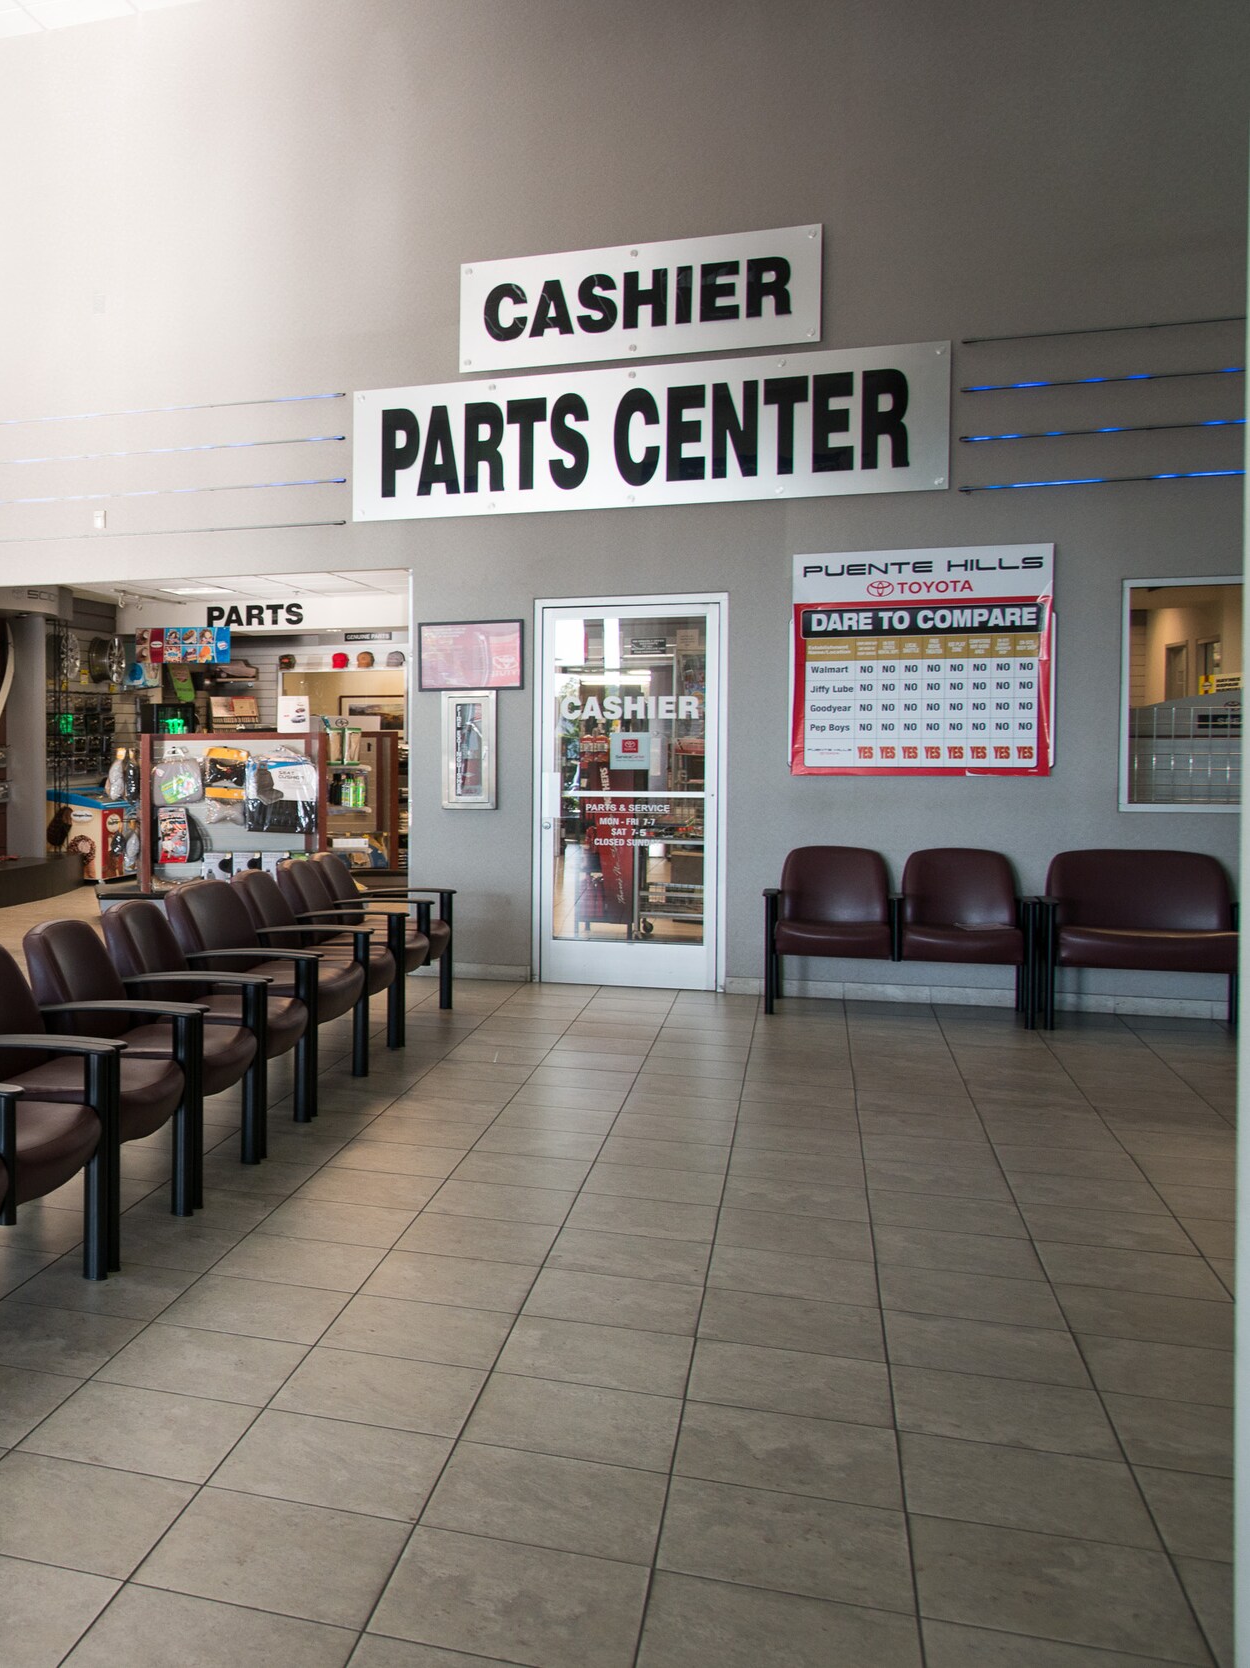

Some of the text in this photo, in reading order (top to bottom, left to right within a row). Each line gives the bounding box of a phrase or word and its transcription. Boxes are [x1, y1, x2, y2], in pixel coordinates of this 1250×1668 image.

[483, 256, 791, 342] CASHIER
[381, 368, 909, 498] PARTS CENTER
[803, 556, 1044, 578] PUENTE HILLS
[897, 580, 973, 594] TOYOTA
[207, 603, 303, 627] PARTS
[811, 607, 1037, 631] DARE TO COMPARE
[811, 666, 849, 674] Walmart
[882, 665, 895, 673] NO
[904, 664, 917, 672] NO
[927, 664, 940, 672] NO
[997, 663, 1010, 671] NO
[810, 685, 830, 695] Jiffy
[832, 685, 854, 693] Lube
[950, 682, 963, 690] NO
[973, 682, 986, 690] NO
[1019, 681, 1033, 689] NO
[561, 696, 699, 719] CASHIER
[810, 704, 852, 713] Goodyear
[904, 703, 917, 711] NO
[927, 703, 940, 711] NO
[996, 702, 1009, 710] NO
[1019, 702, 1032, 710] NO
[810, 724, 826, 732] Pep
[829, 724, 850, 732] Boys
[882, 723, 894, 731] NO
[1019, 722, 1032, 730] NO
[858, 747, 873, 759] YES
[880, 747, 895, 759] YES
[902, 747, 917, 759] YES
[924, 747, 940, 759] YES
[947, 746, 963, 759] YES
[970, 746, 986, 759] YES
[994, 746, 1010, 759] YES
[1017, 746, 1033, 759] YES
[585, 804, 670, 812] PARTS & SERVICE
[631, 828, 646, 836] 7-5
[594, 838, 624, 846] CLOSED
